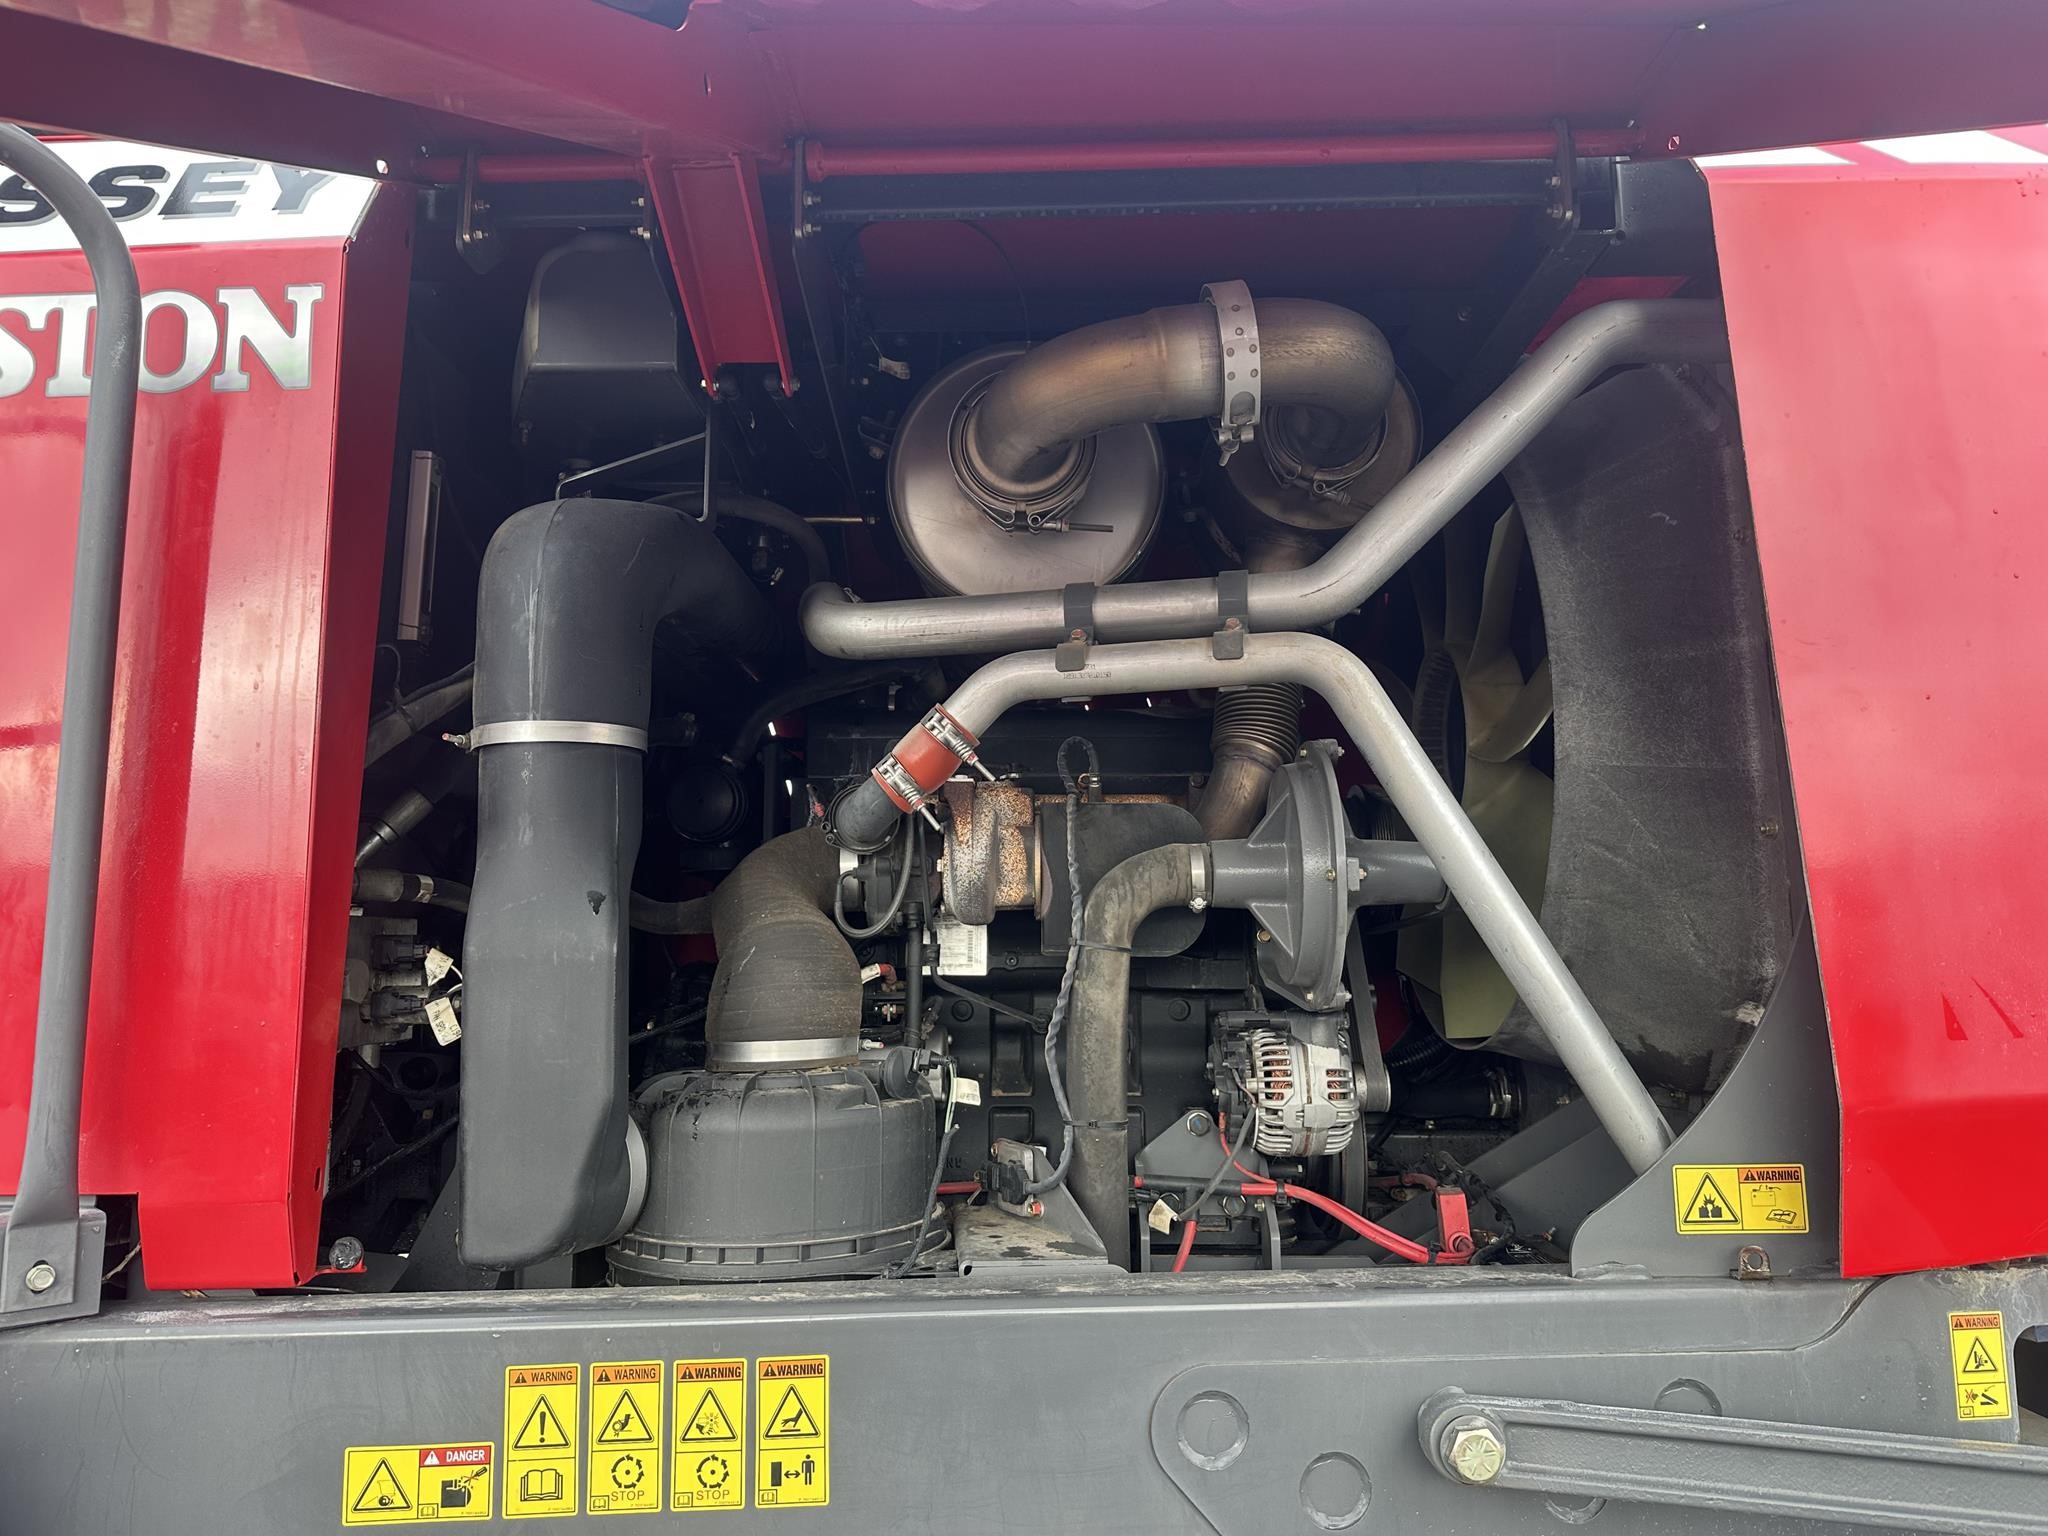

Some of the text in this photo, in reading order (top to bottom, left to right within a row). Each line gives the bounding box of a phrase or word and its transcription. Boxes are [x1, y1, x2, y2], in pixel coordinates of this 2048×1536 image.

[1756, 1170, 1800, 1181] WARNING
[1964, 1316, 1999, 1328] WARNING
[614, 1367, 656, 1380] WARNING
[694, 1366, 742, 1380] WARNING
[776, 1362, 824, 1376] WARNING
[530, 1370, 573, 1382] WARNING
[446, 1449, 485, 1462] DANGER
[610, 1490, 646, 1502] STOP
[695, 1489, 731, 1501] STOP
